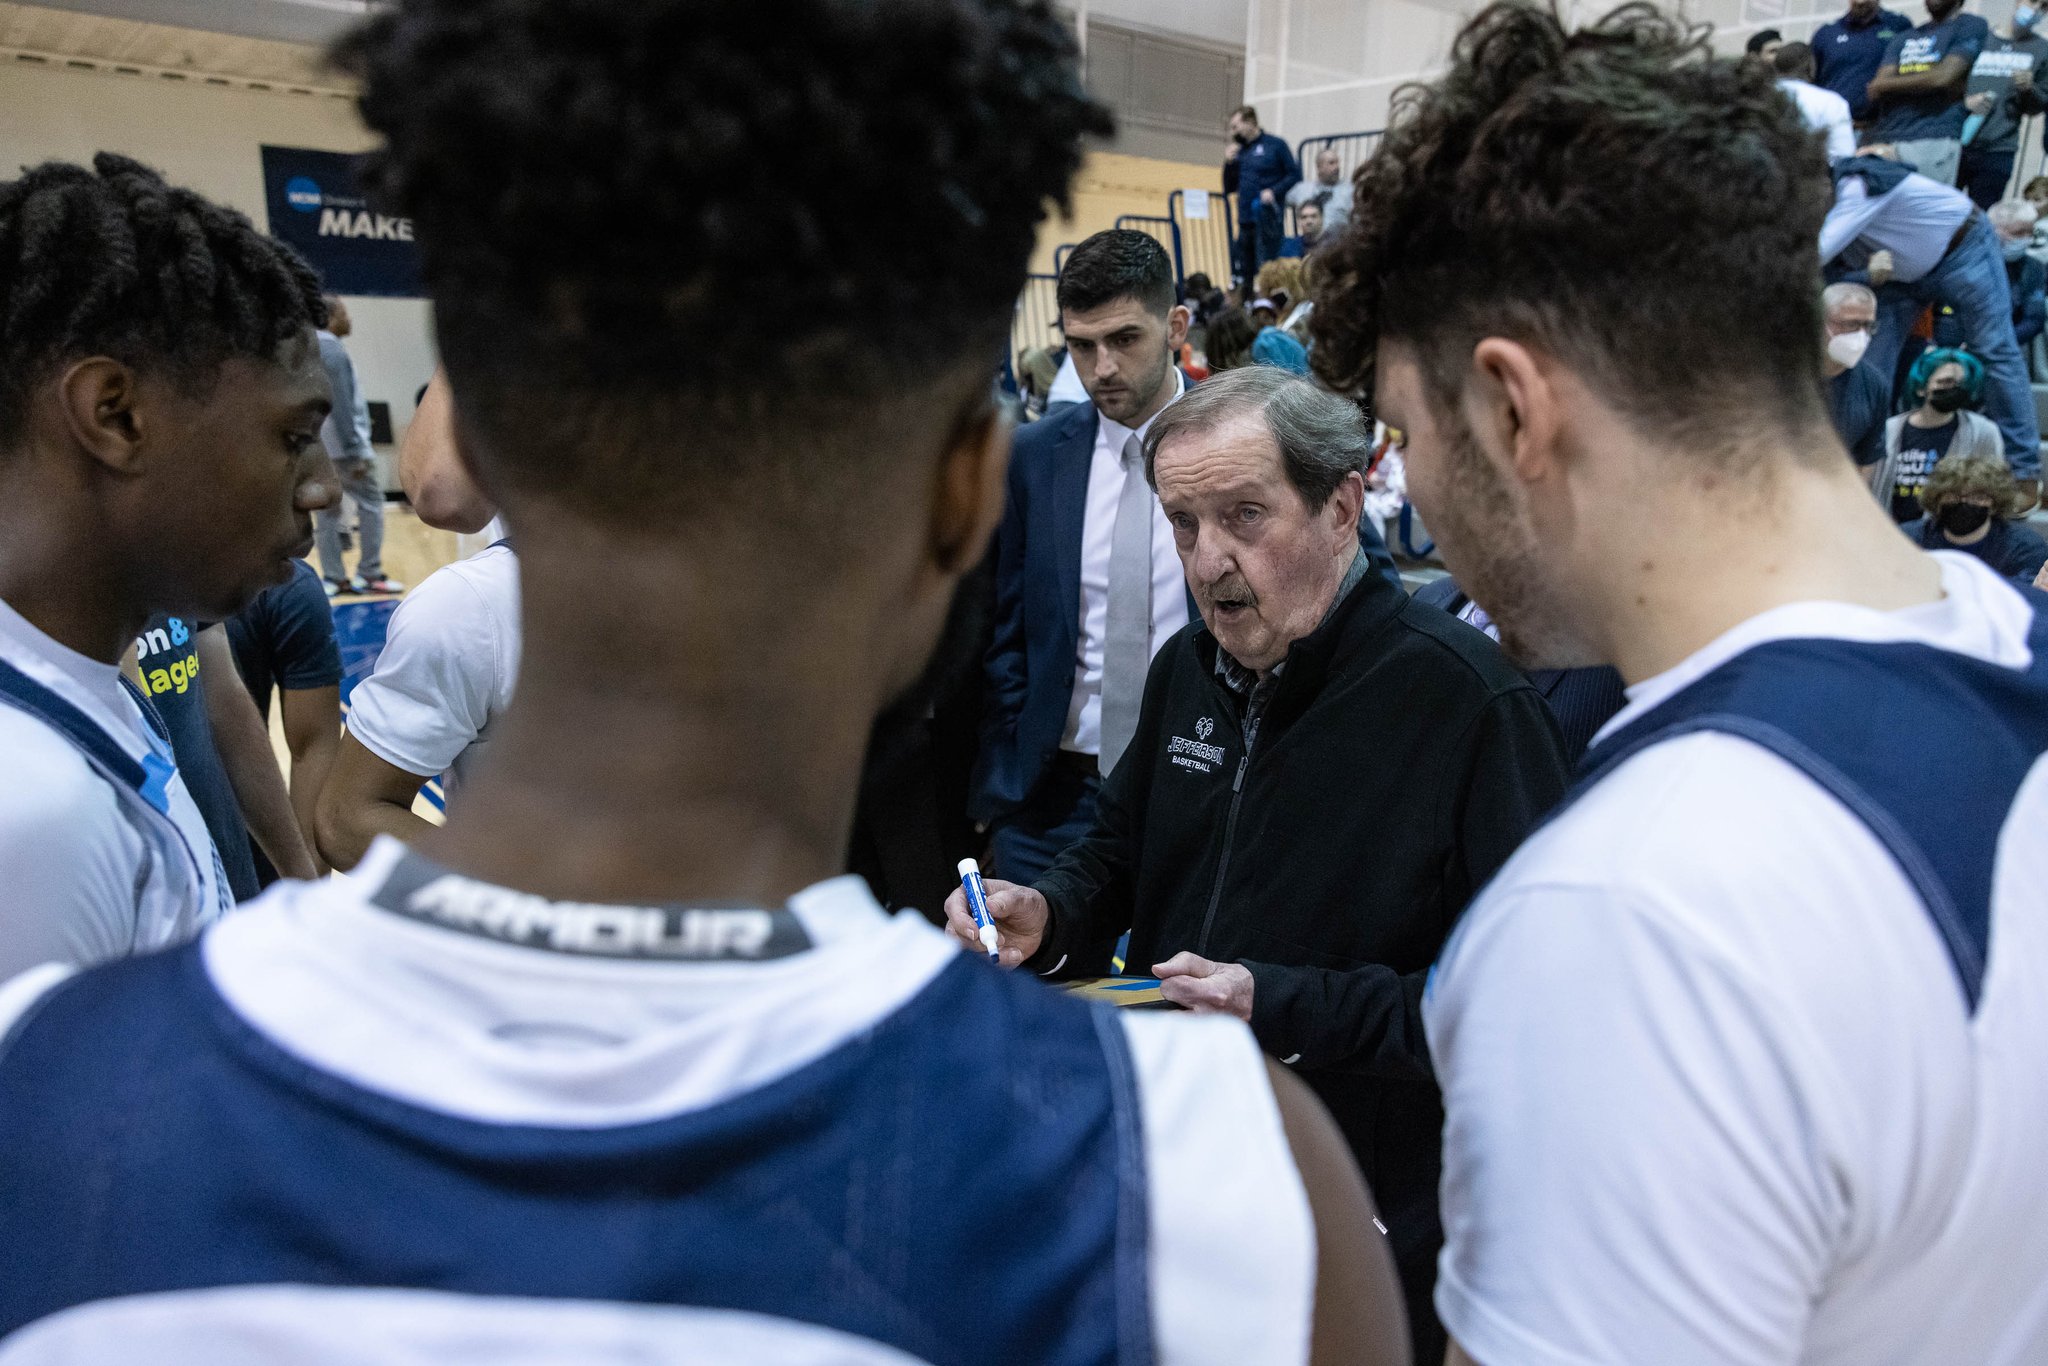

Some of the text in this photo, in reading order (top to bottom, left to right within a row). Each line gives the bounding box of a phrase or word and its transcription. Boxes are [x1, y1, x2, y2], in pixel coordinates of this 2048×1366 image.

[319, 208, 414, 241] MAKE
[1168, 735, 1225, 765] JEFFERSON
[1172, 755, 1211, 773] BASKETBALL
[408, 873, 774, 957] ARMOUR
